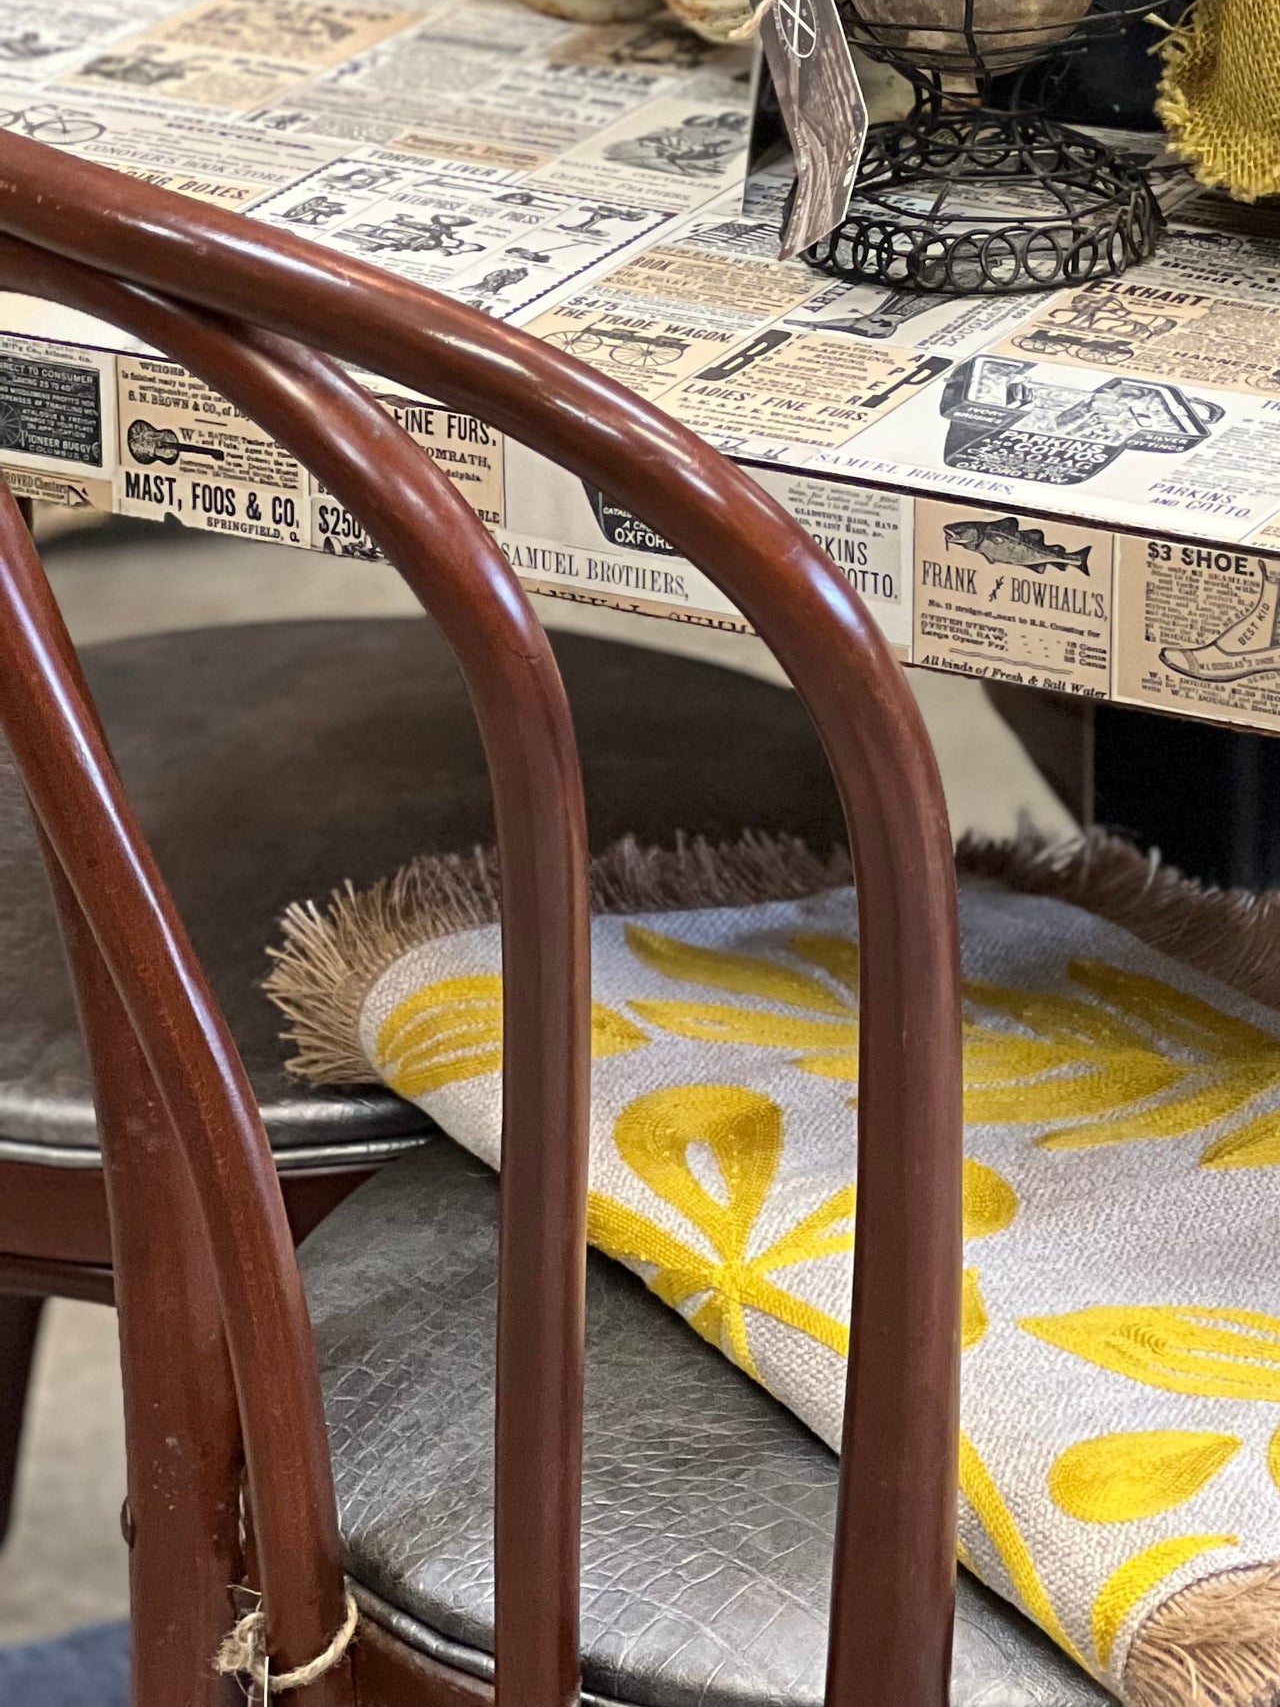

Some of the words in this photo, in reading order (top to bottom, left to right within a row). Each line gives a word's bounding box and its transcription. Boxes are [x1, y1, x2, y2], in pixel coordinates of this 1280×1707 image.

[367, 150, 434, 167] TORPID
[442, 162, 497, 178] LIVER
[628, 256, 675, 272] BOOK
[566, 296, 619, 312] $475
[1084, 281, 1213, 307] ELKHART
[552, 306, 593, 320] THE
[598, 314, 659, 331] TRADE
[664, 323, 736, 343] WAGON.
[1172, 351, 1273, 372] HARNESS
[28, 366, 39, 376] TO
[41, 369, 94, 384] CONSUMER
[151, 395, 189, 410] BROWN
[193, 401, 200, 411] &
[222, 406, 232, 416] of
[682, 384, 757, 402] LADIES'
[761, 396, 810, 413] FINE
[817, 406, 869, 423] FURS.
[21, 429, 60, 448] PIONEER
[62, 440, 91, 454] BUGGY
[447, 413, 497, 447] FURS.
[999, 430, 1106, 454] PARKINS
[1145, 434, 1189, 444] SILVER
[29, 444, 80, 459] COLUMBUS
[420, 446, 491, 470] OMRATH,
[814, 452, 898, 475] SAMUEL
[956, 461, 1022, 477] OXFORD
[125, 471, 182, 511] MAST,
[191, 483, 236, 517] FOOS
[245, 492, 262, 522] &
[1148, 483, 1237, 504] PARKINS
[1150, 497, 1179, 507] AND
[207, 517, 284, 541] SPRINGFIELD,
[501, 542, 579, 578] SAMUEL
[586, 556, 690, 601] BROTHERS,
[1147, 542, 1172, 561] $3
[1181, 547, 1255, 577] SHOE.
[838, 566, 898, 599] OTTO.
[921, 560, 977, 595] FRANK
[1011, 577, 1109, 622] BOWHALL'S,
[921, 612, 963, 627] OYSTER
[965, 620, 1008, 636] STEWS,
[1237, 622, 1259, 646] BEST
[1258, 602, 1270, 623] KID
[921, 655, 940, 667] All
[942, 657, 974, 674] kinds
[975, 664, 988, 677] of
[991, 667, 1024, 683] Fresh
[1028, 675, 1039, 686] &
[1042, 677, 1066, 692] Salt
